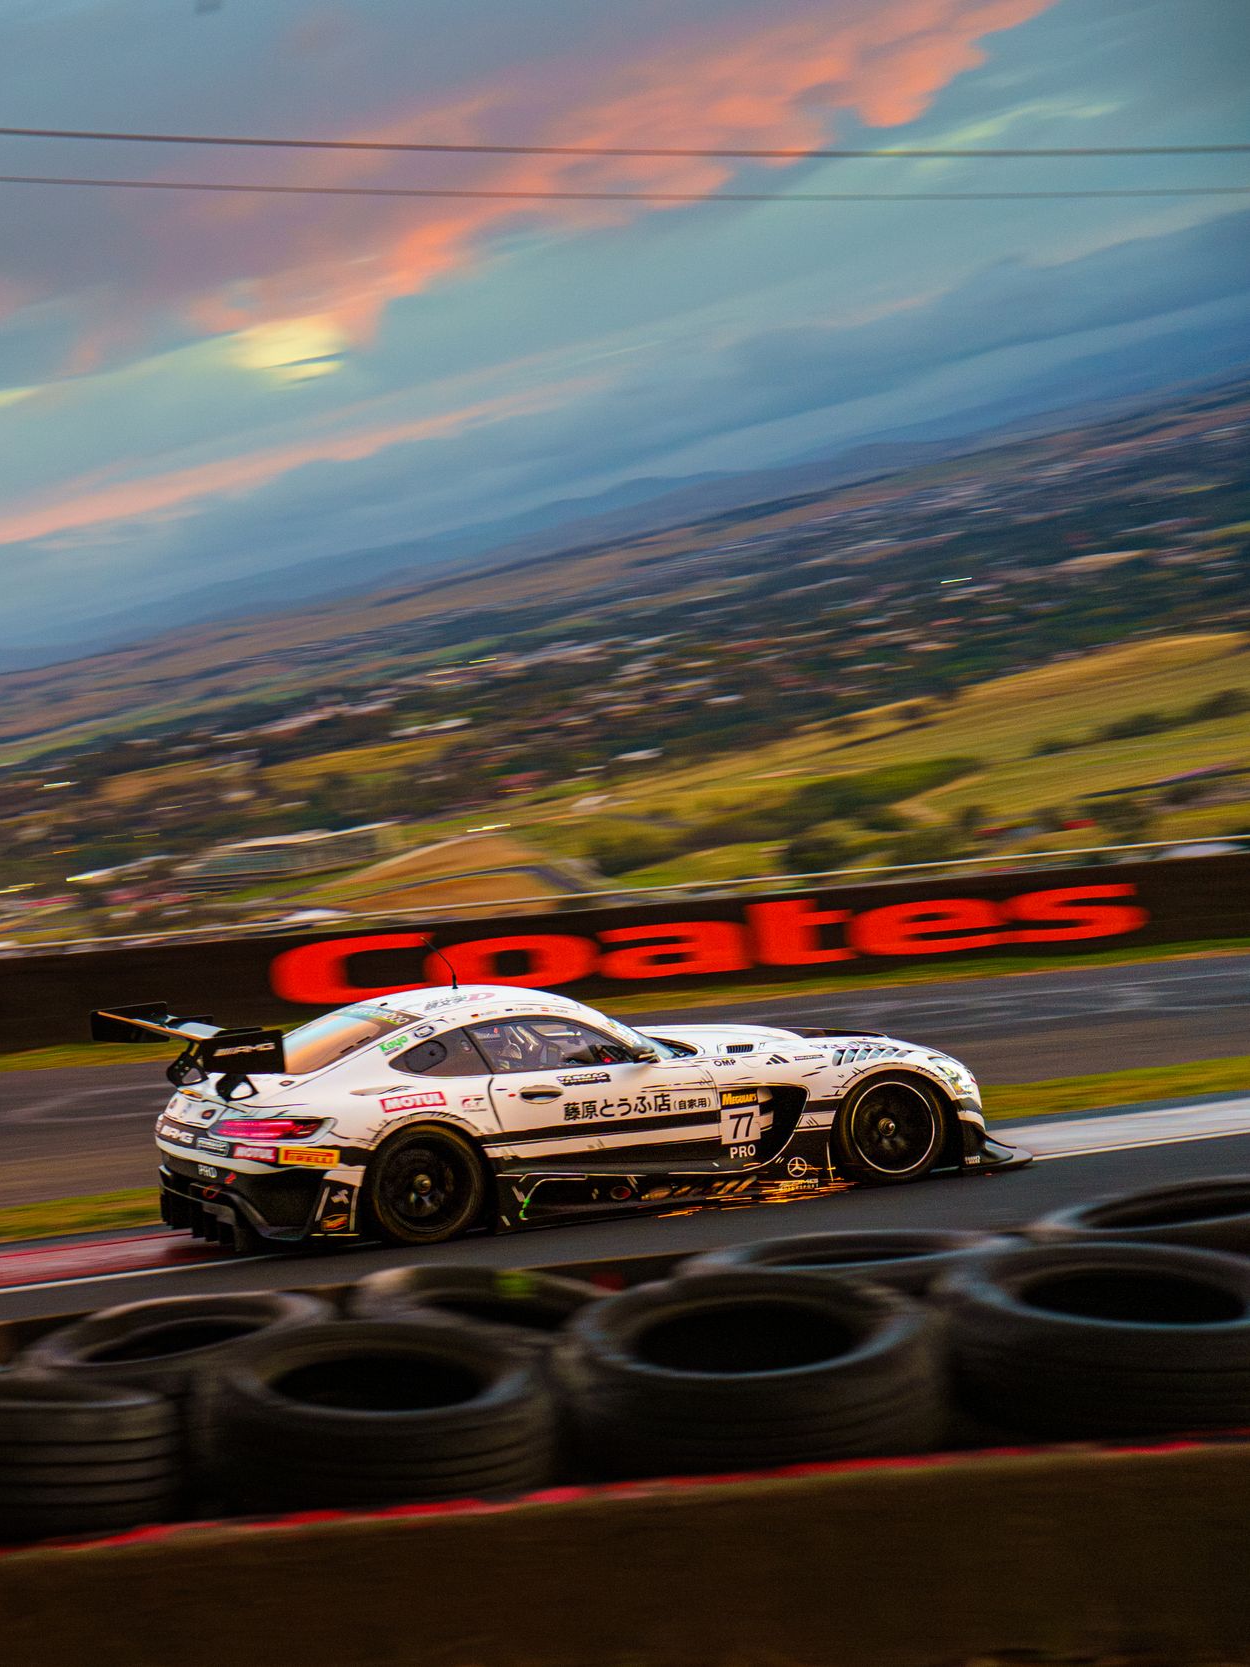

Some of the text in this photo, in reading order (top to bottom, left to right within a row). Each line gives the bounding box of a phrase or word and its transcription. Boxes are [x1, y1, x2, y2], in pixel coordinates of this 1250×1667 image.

[270, 883, 1144, 1003] Coates
[379, 1036, 408, 1052] Kayo
[714, 1059, 736, 1067] OMP
[385, 1093, 444, 1110] MOTUL
[729, 1112, 754, 1139] 77
[236, 1147, 274, 1159] MOTUL
[284, 1150, 334, 1164] PIRELLI
[730, 1144, 756, 1159] PRO
[197, 1163, 217, 1178] PRO
